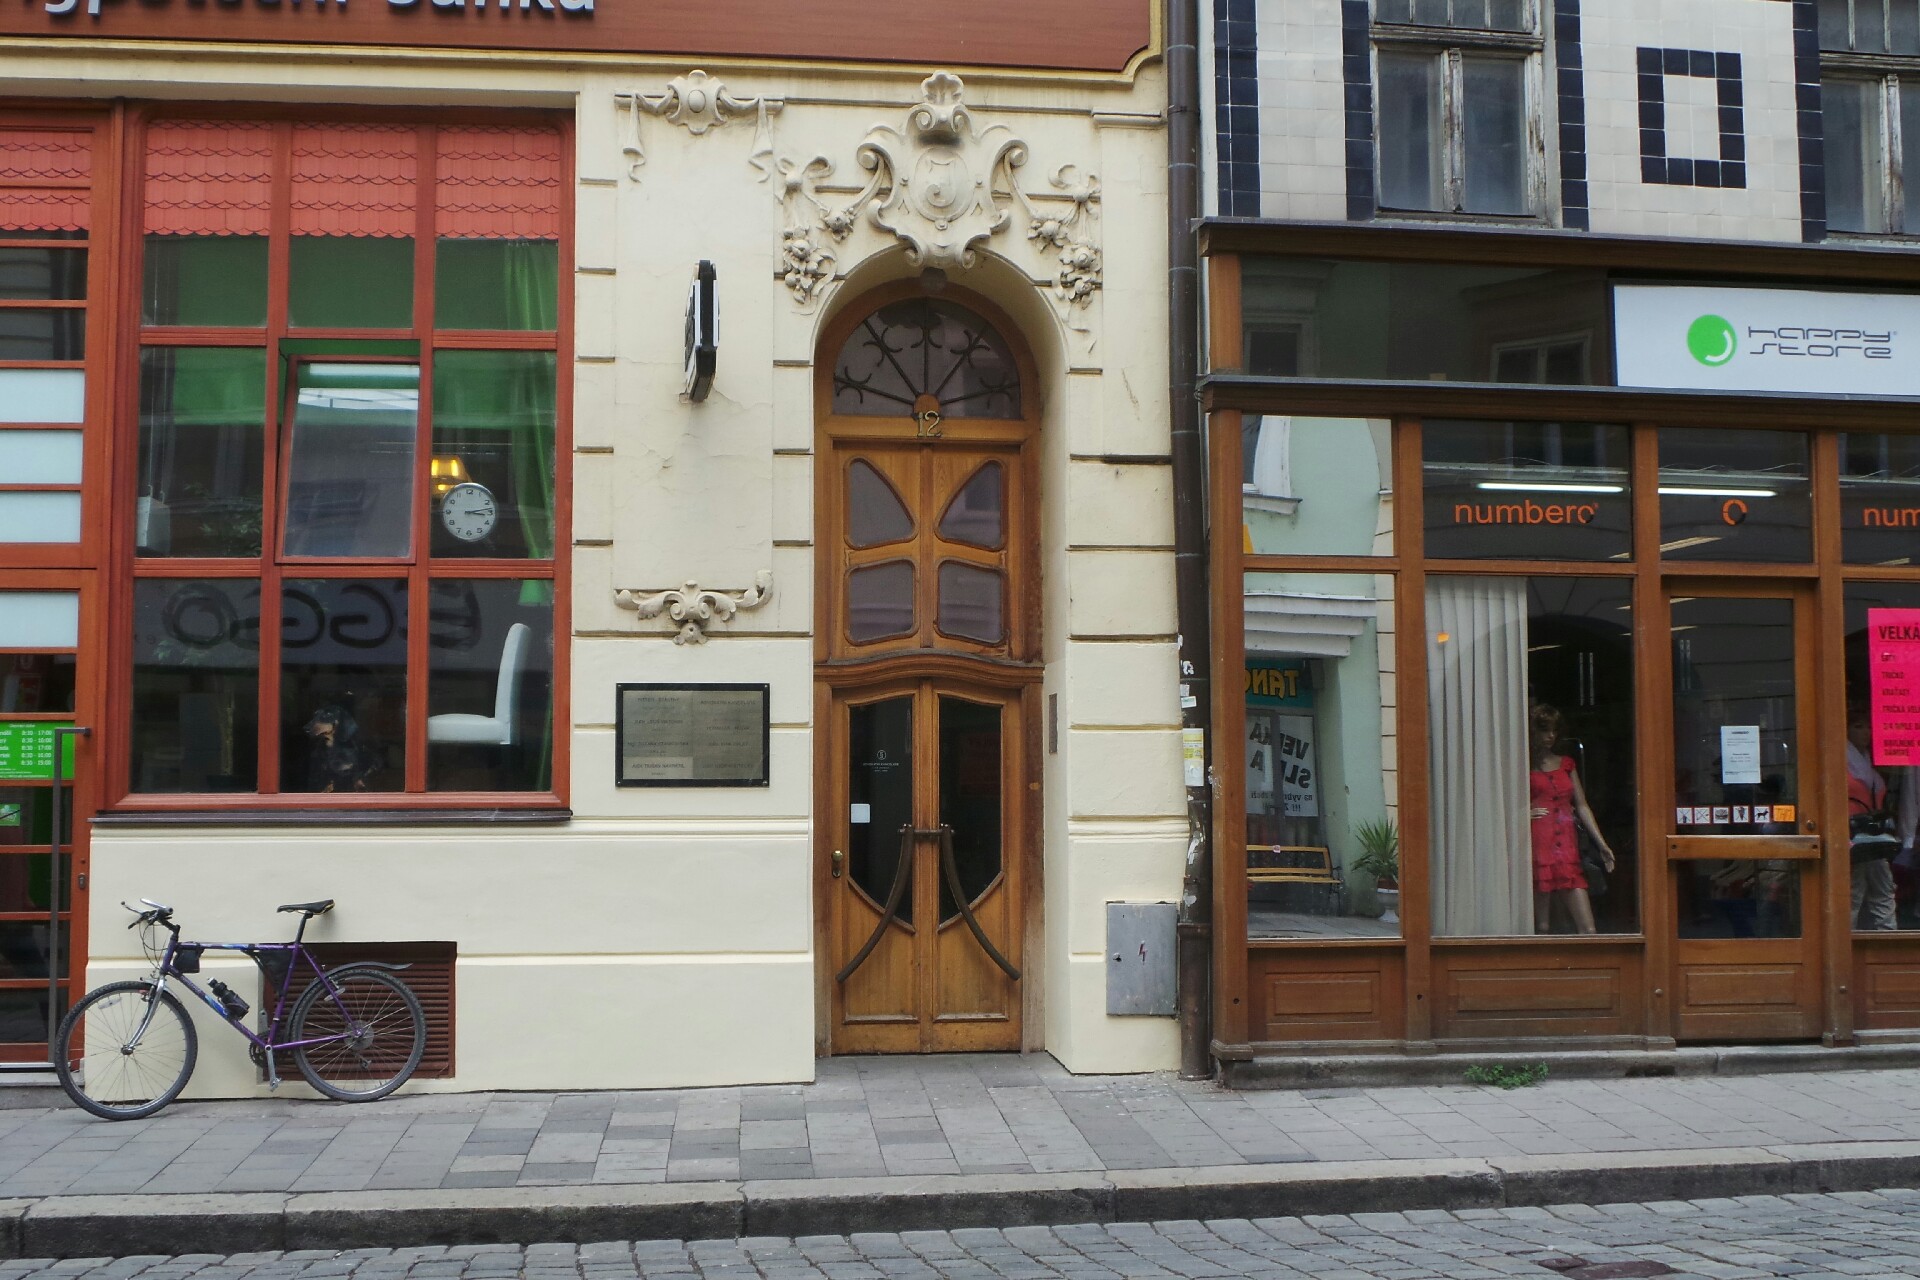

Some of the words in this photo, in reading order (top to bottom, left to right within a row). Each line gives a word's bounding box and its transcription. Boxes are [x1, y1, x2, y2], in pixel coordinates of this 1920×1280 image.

[1748, 325, 1891, 343] happy
[1750, 342, 1892, 359] store
[917, 410, 942, 438] 12
